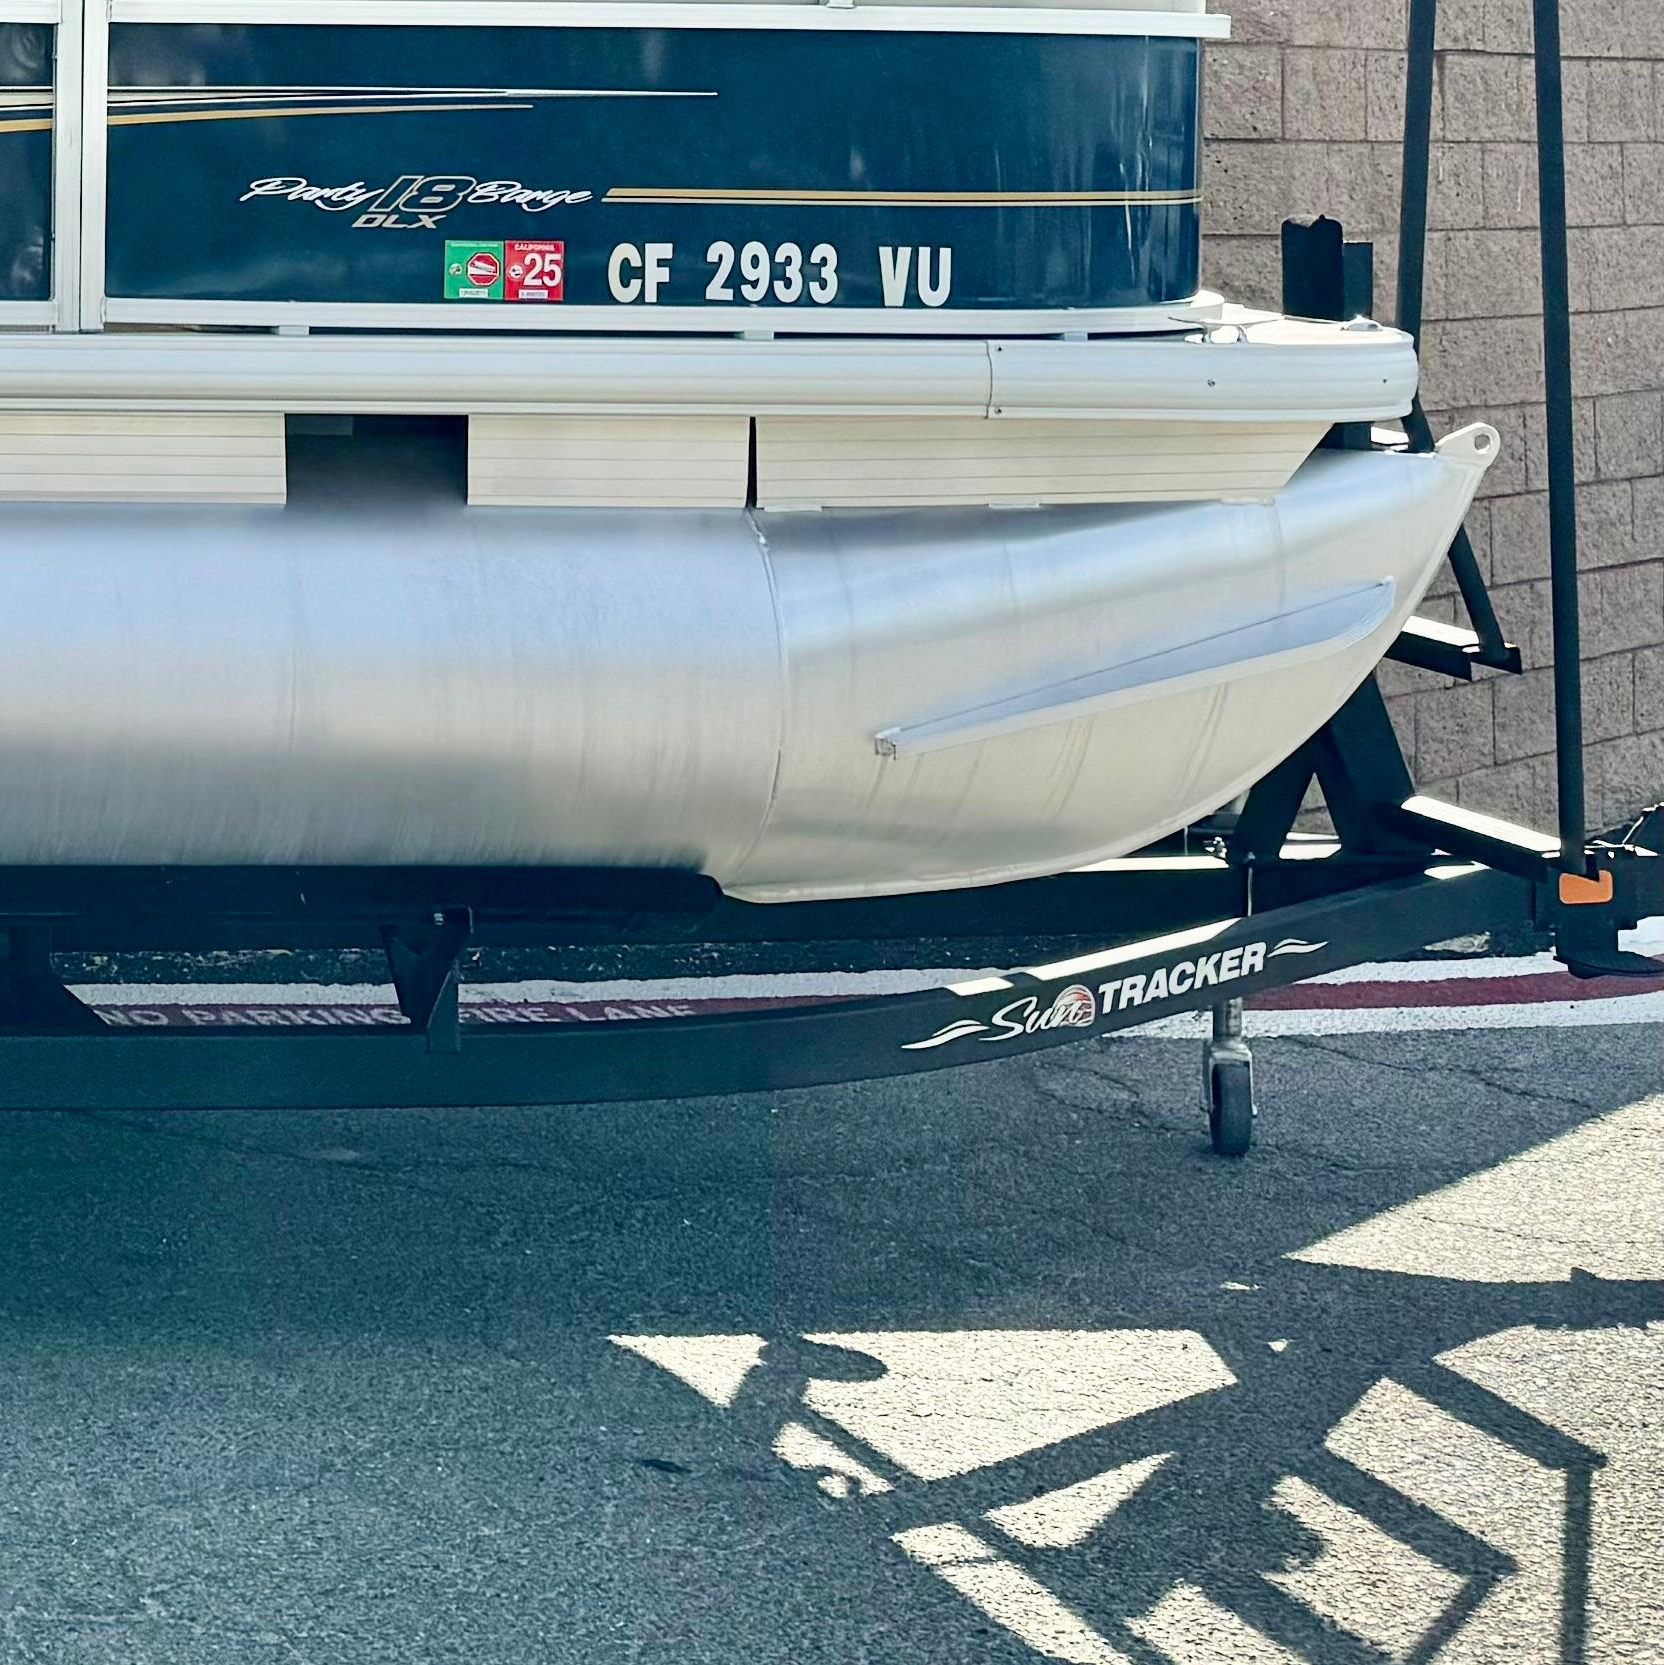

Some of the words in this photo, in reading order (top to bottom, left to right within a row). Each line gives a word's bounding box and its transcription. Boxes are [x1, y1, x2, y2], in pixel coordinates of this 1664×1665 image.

[240, 176, 385, 212] Party
[368, 174, 477, 213] 18
[467, 180, 594, 213] Barge
[351, 213, 447, 229] DLX
[523, 252, 562, 287] 25
[607, 242, 673, 304] CF
[705, 240, 839, 304] 2933
[878, 246, 952, 308] VU
[979, 995, 1086, 1041] Sun
[1098, 940, 1268, 1015] TRACKER
[93, 1008, 170, 1026] NO
[180, 1007, 412, 1026] PARKING
